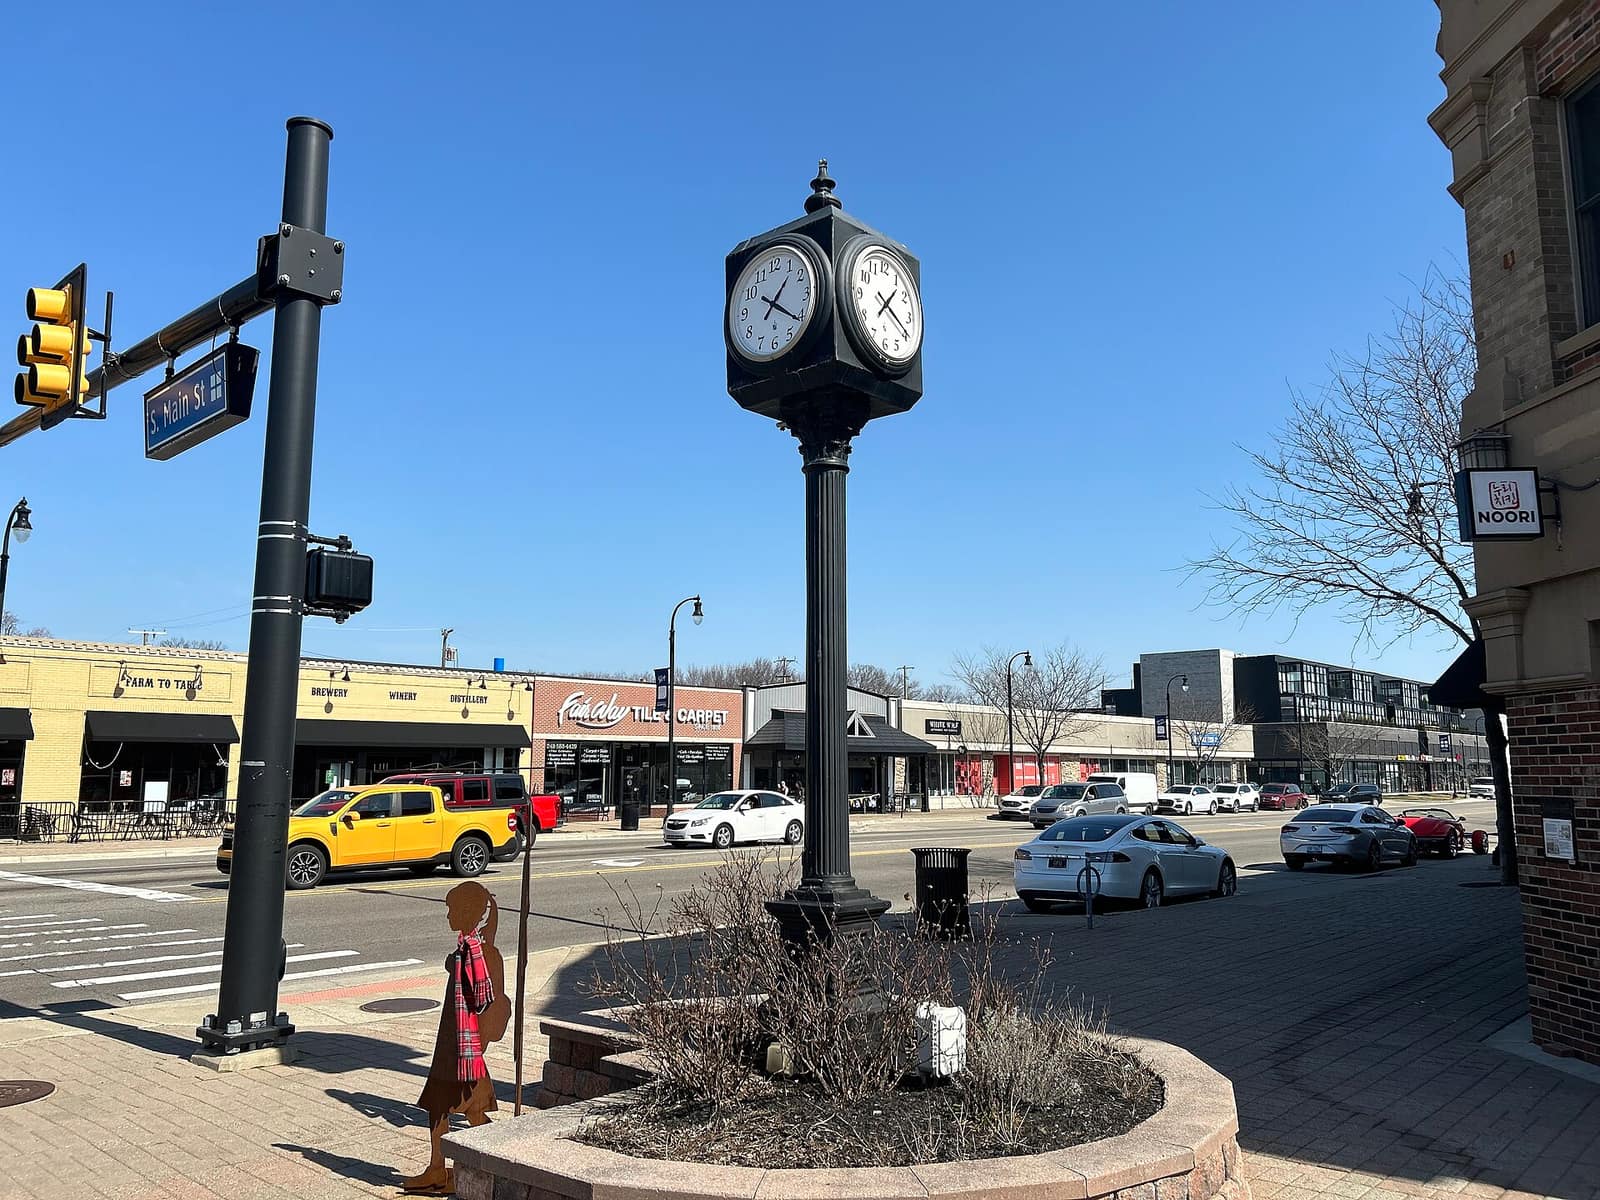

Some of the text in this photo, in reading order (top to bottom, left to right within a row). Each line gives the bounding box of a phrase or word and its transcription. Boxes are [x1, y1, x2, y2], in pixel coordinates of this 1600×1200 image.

[769, 258, 781, 273] 12
[787, 259, 793, 273] 1
[868, 260, 877, 275] 11
[880, 261, 889, 276] 12
[755, 269, 767, 284] 11
[797, 269, 804, 282] 2
[861, 270, 870, 285] 10
[745, 285, 758, 301] 10
[803, 287, 810, 301] 3
[857, 286, 863, 300] 9
[902, 291, 907, 304] 2
[741, 308, 748, 321] 9
[906, 312, 912, 324] 3
[745, 325, 753, 339] 8
[786, 326, 793, 341] 5
[758, 336, 764, 350] 7
[771, 336, 779, 350] 6
[882, 338, 888, 351] 6
[893, 339, 899, 352] 5
[150, 379, 206, 435] S. Main St
[1479, 511, 1535, 523] NOORI
[126, 677, 154, 688] FARM
[157, 679, 171, 689] TO
[311, 687, 348, 697] BREWERY
[389, 691, 417, 700] WINERY
[450, 694, 488, 704] DISTILLERY
[632, 706, 662, 723] TILE
[677, 708, 728, 725] CARPET
